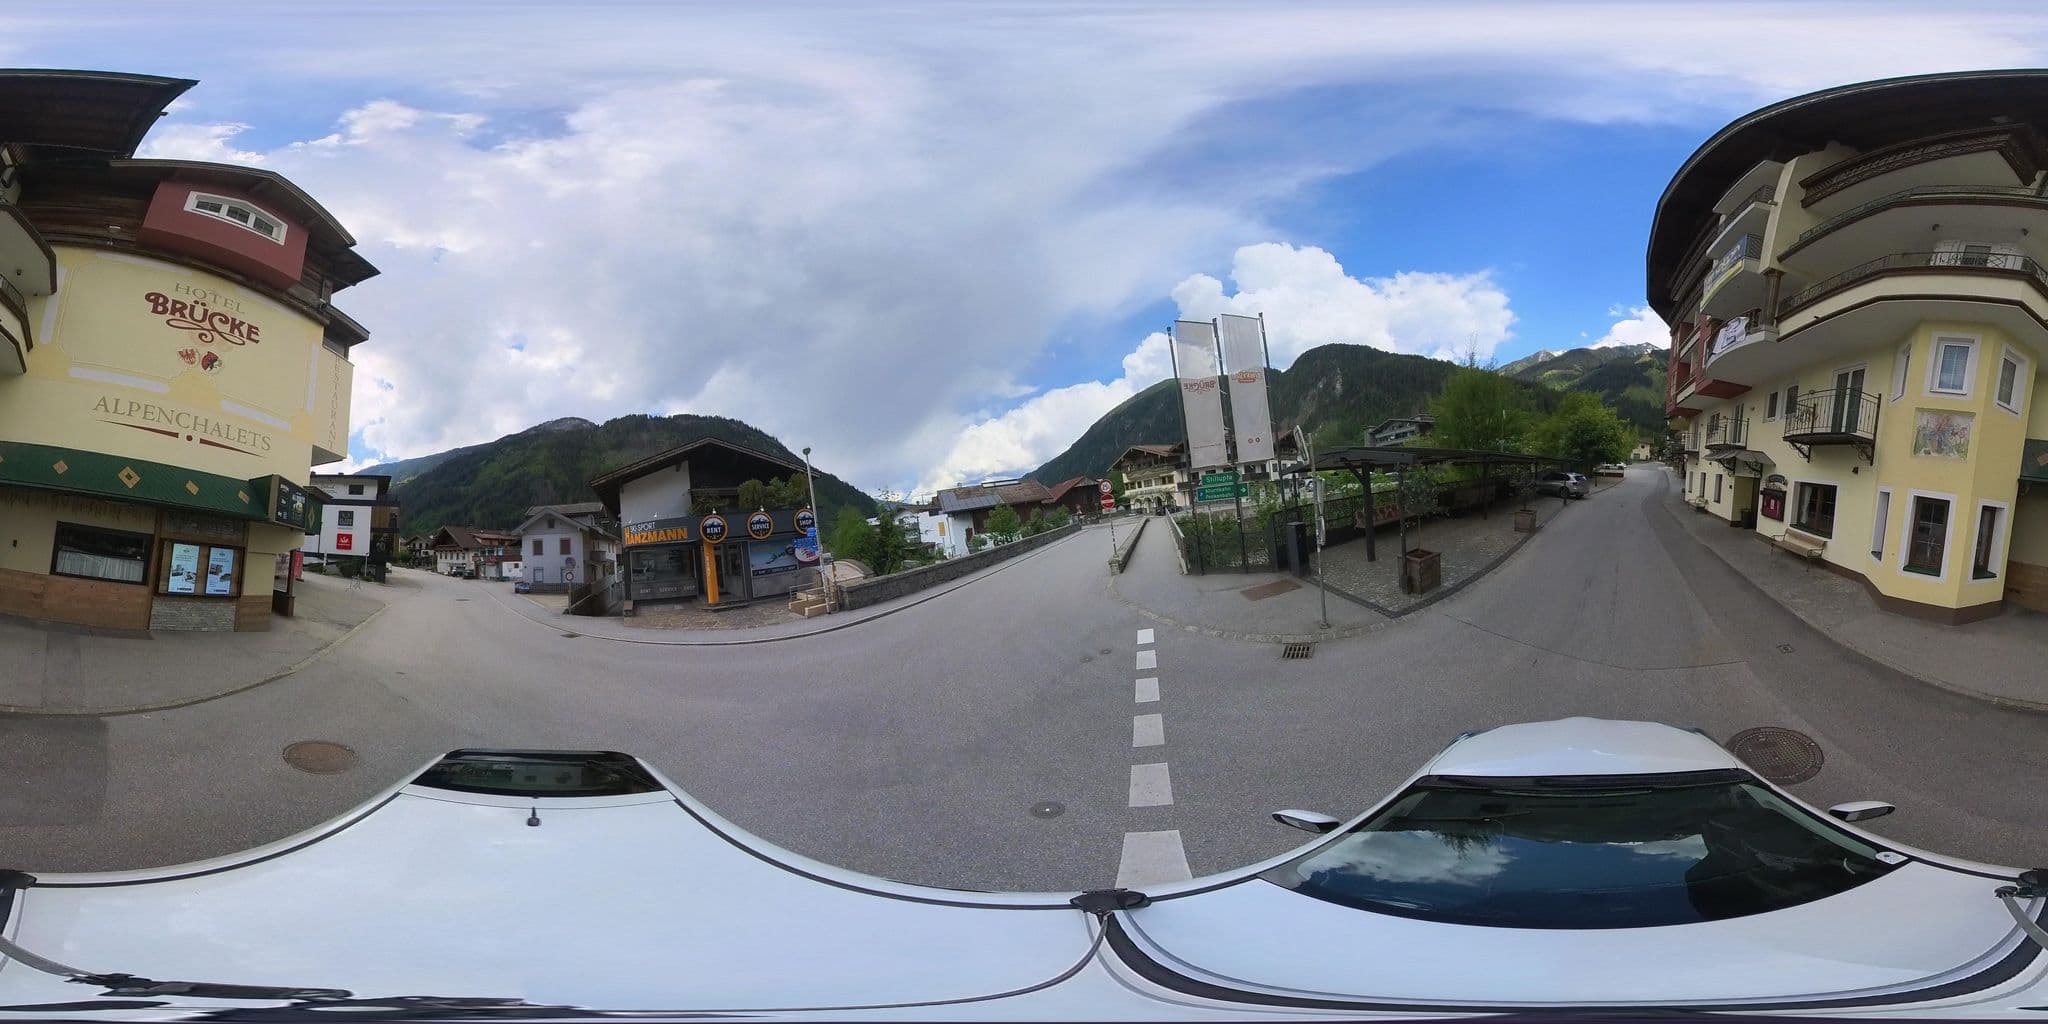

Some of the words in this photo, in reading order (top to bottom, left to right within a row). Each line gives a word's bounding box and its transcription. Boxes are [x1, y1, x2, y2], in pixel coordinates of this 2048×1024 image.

[144, 292, 260, 345] BRÜCKE
[174, 283, 247, 315] HOTEL
[93, 395, 272, 452] ALPENCHALETS
[752, 523, 770, 531] SERVICE
